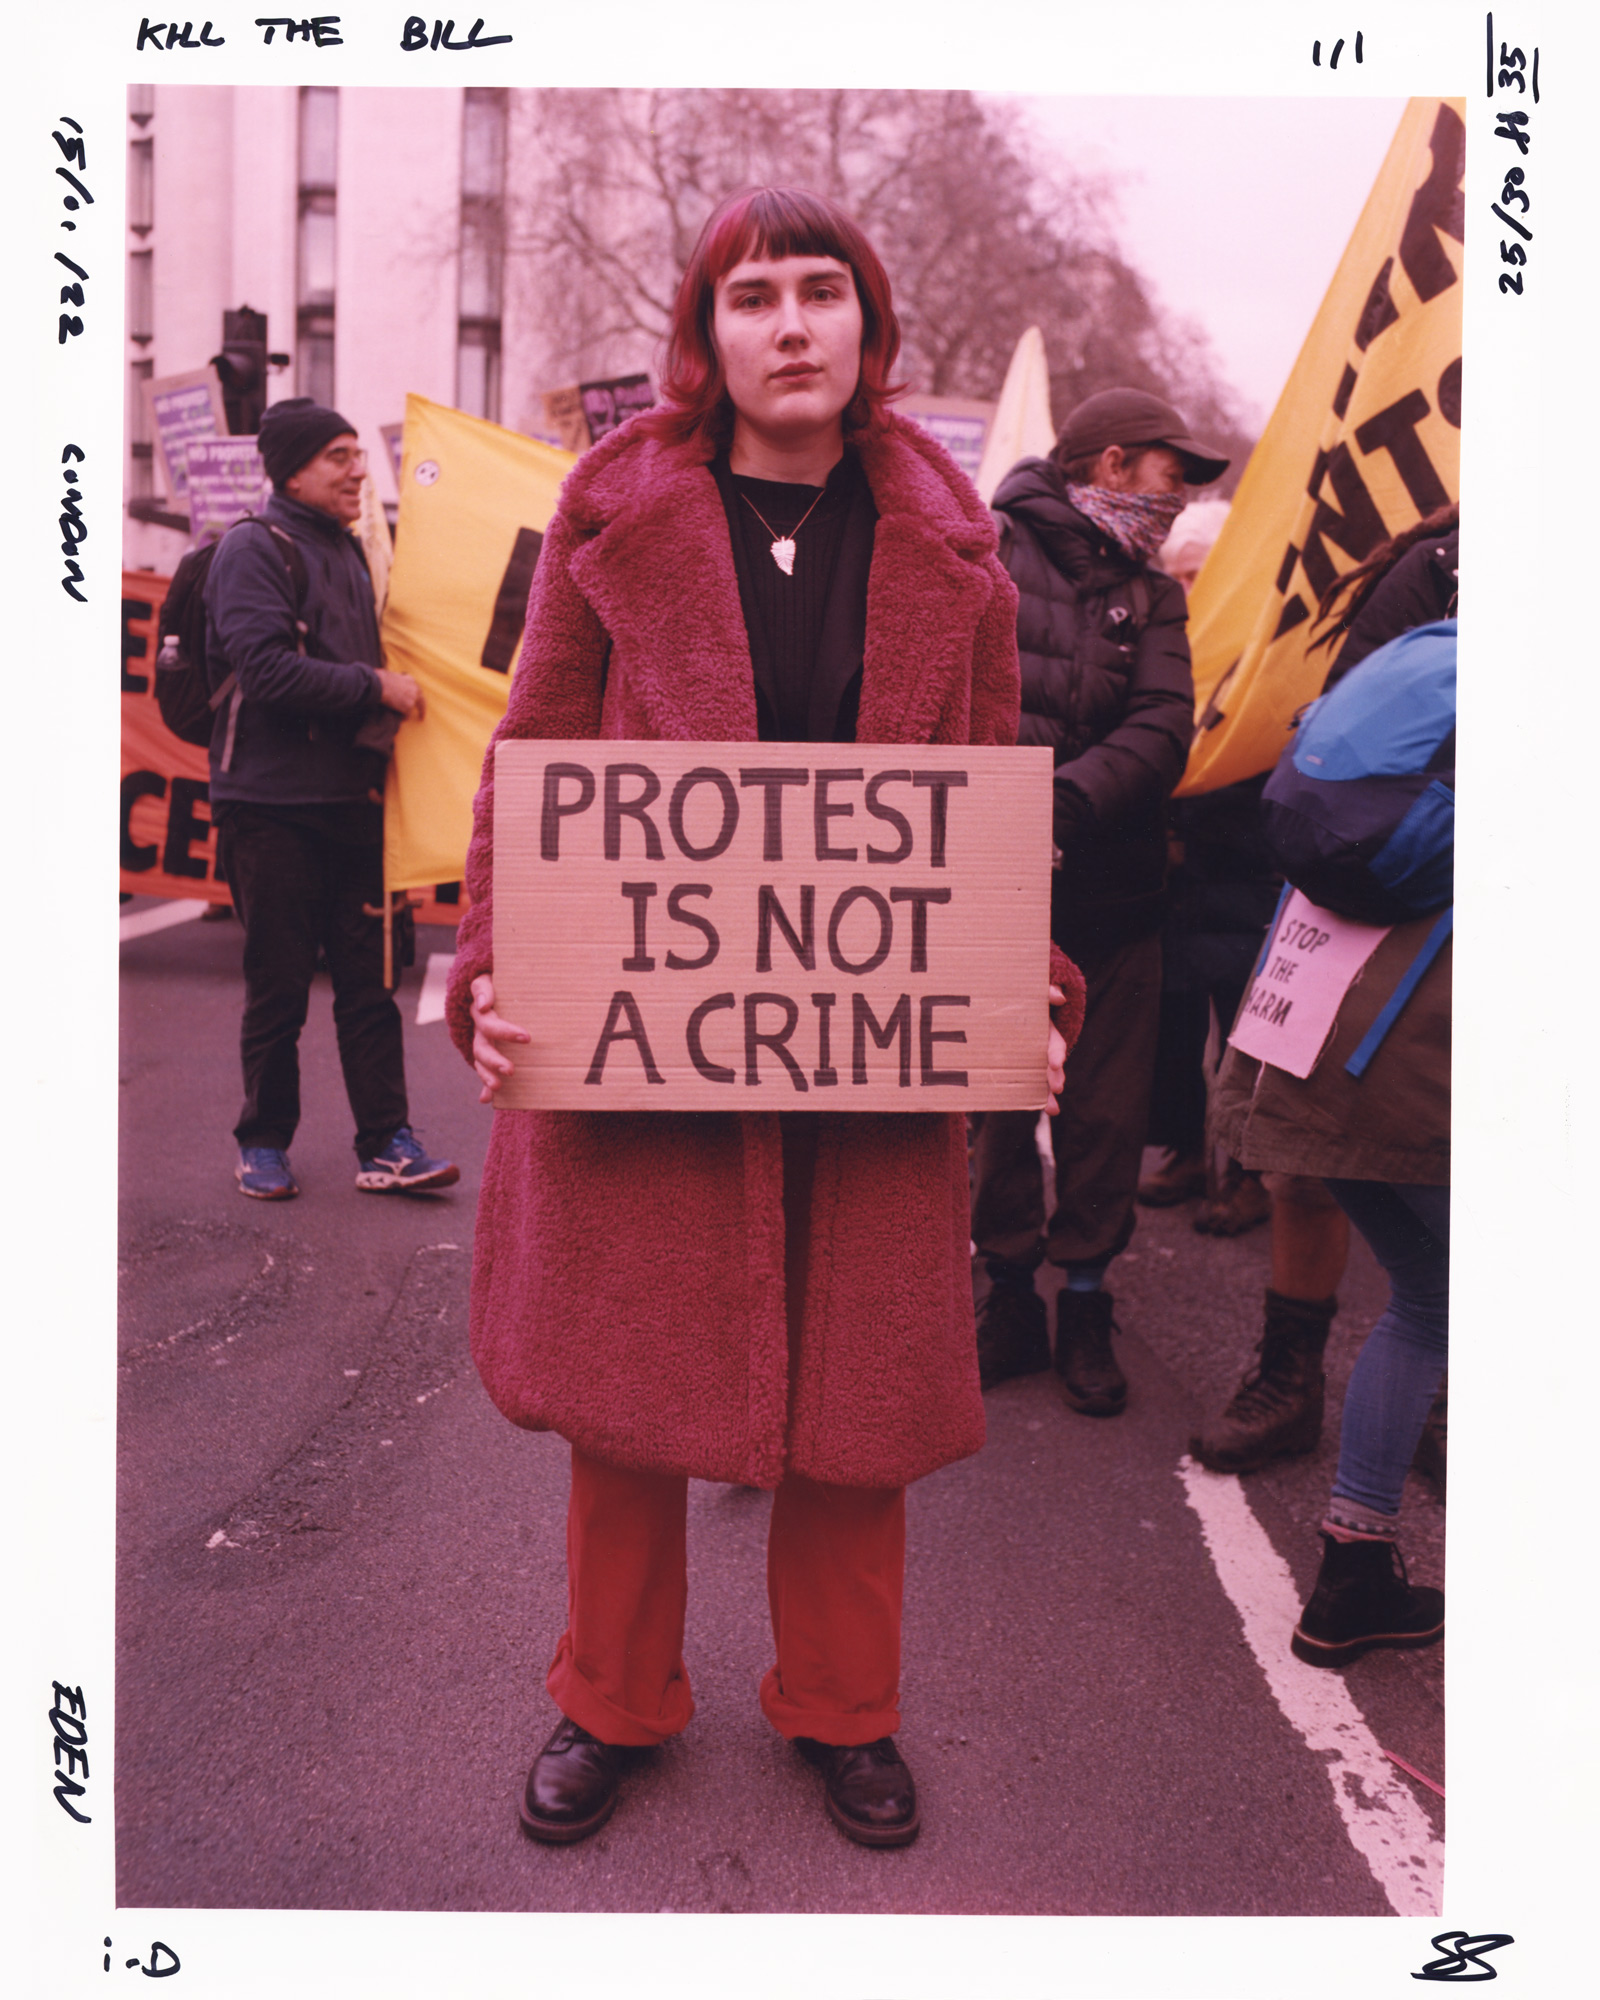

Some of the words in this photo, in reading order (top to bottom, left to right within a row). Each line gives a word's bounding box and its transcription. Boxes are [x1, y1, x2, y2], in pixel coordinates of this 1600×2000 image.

[137, 17, 226, 50] KILL
[255, 16, 344, 48] THE
[401, 15, 513, 51] BILL
[540, 762, 968, 868] PROTEST
[622, 881, 720, 973] IS
[756, 884, 952, 975] NOT
[1279, 918, 1331, 954] STOP
[1268, 955, 1299, 985] THE
[584, 990, 667, 1086] A
[686, 991, 971, 1092] CRIME
[48, 1680, 92, 1824] EDEN
[103, 1936, 181, 1978] i-D
